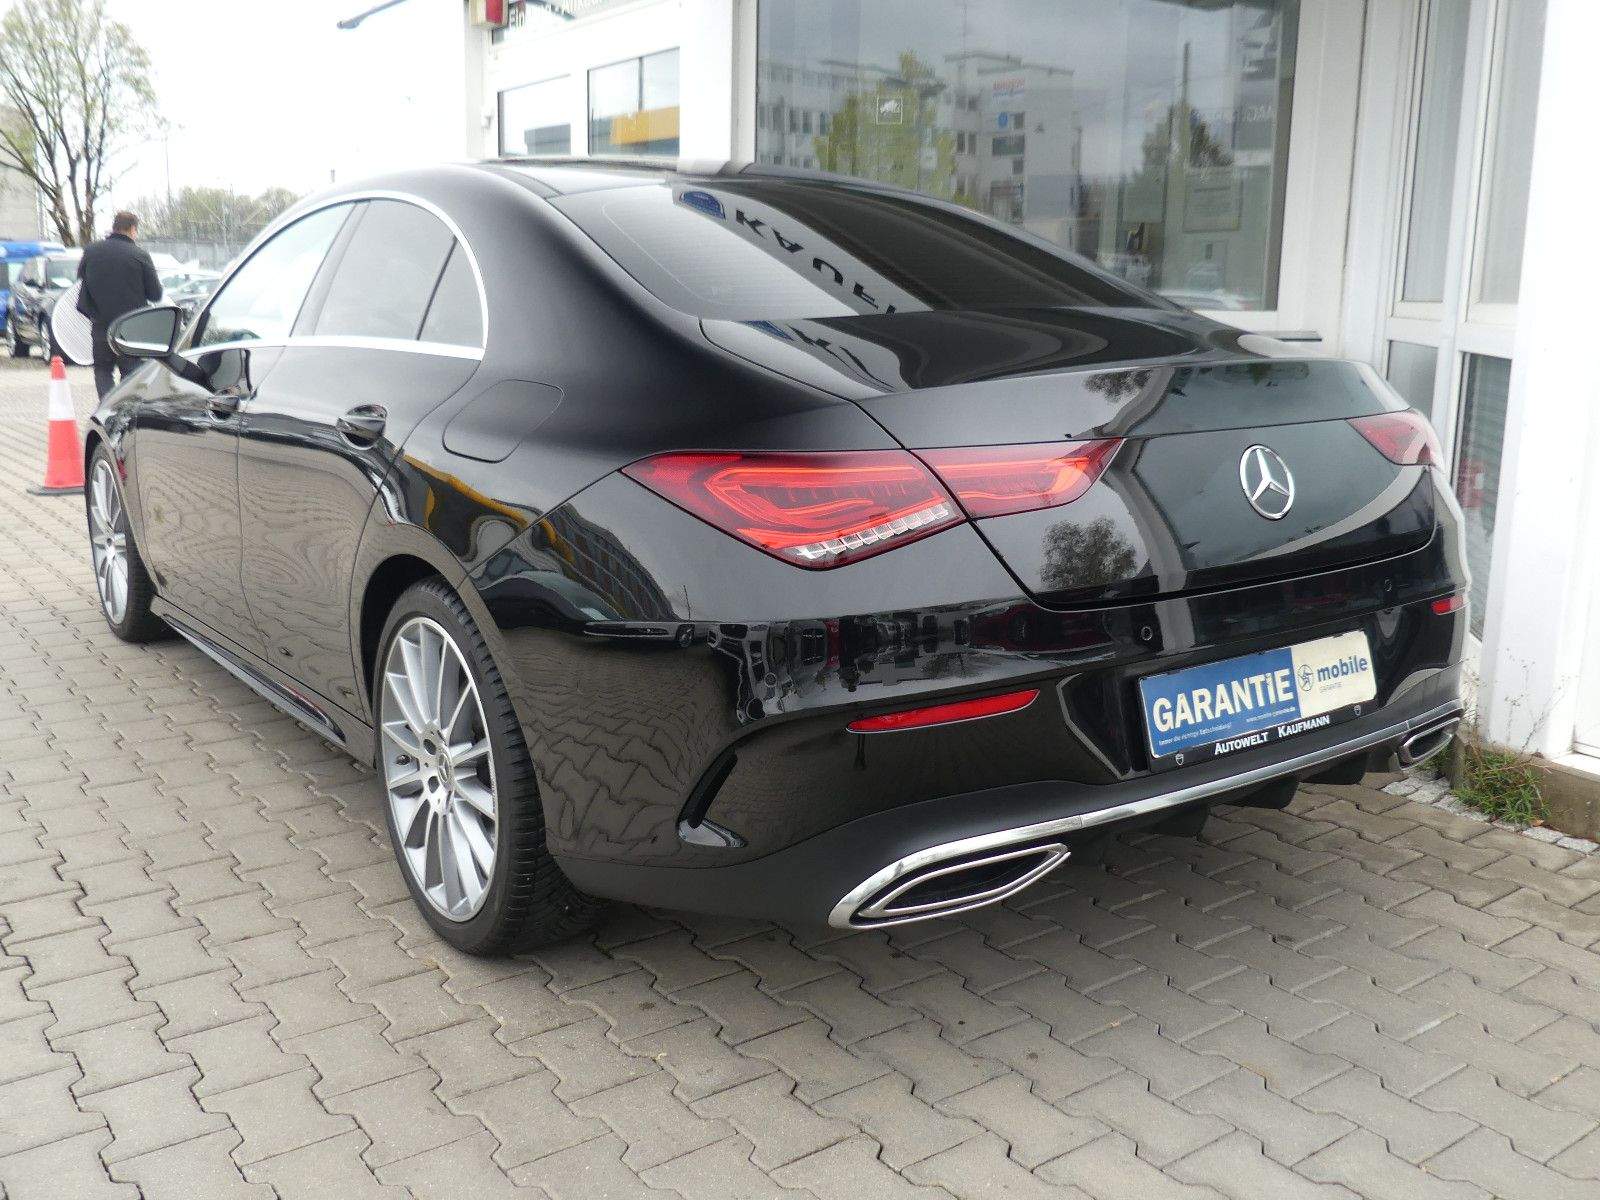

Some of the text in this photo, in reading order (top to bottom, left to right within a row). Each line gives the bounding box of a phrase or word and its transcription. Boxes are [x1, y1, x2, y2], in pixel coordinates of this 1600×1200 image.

[1316, 655, 1368, 682] mobile
[1214, 715, 1330, 755] AUTOWELT KAUFMANN
